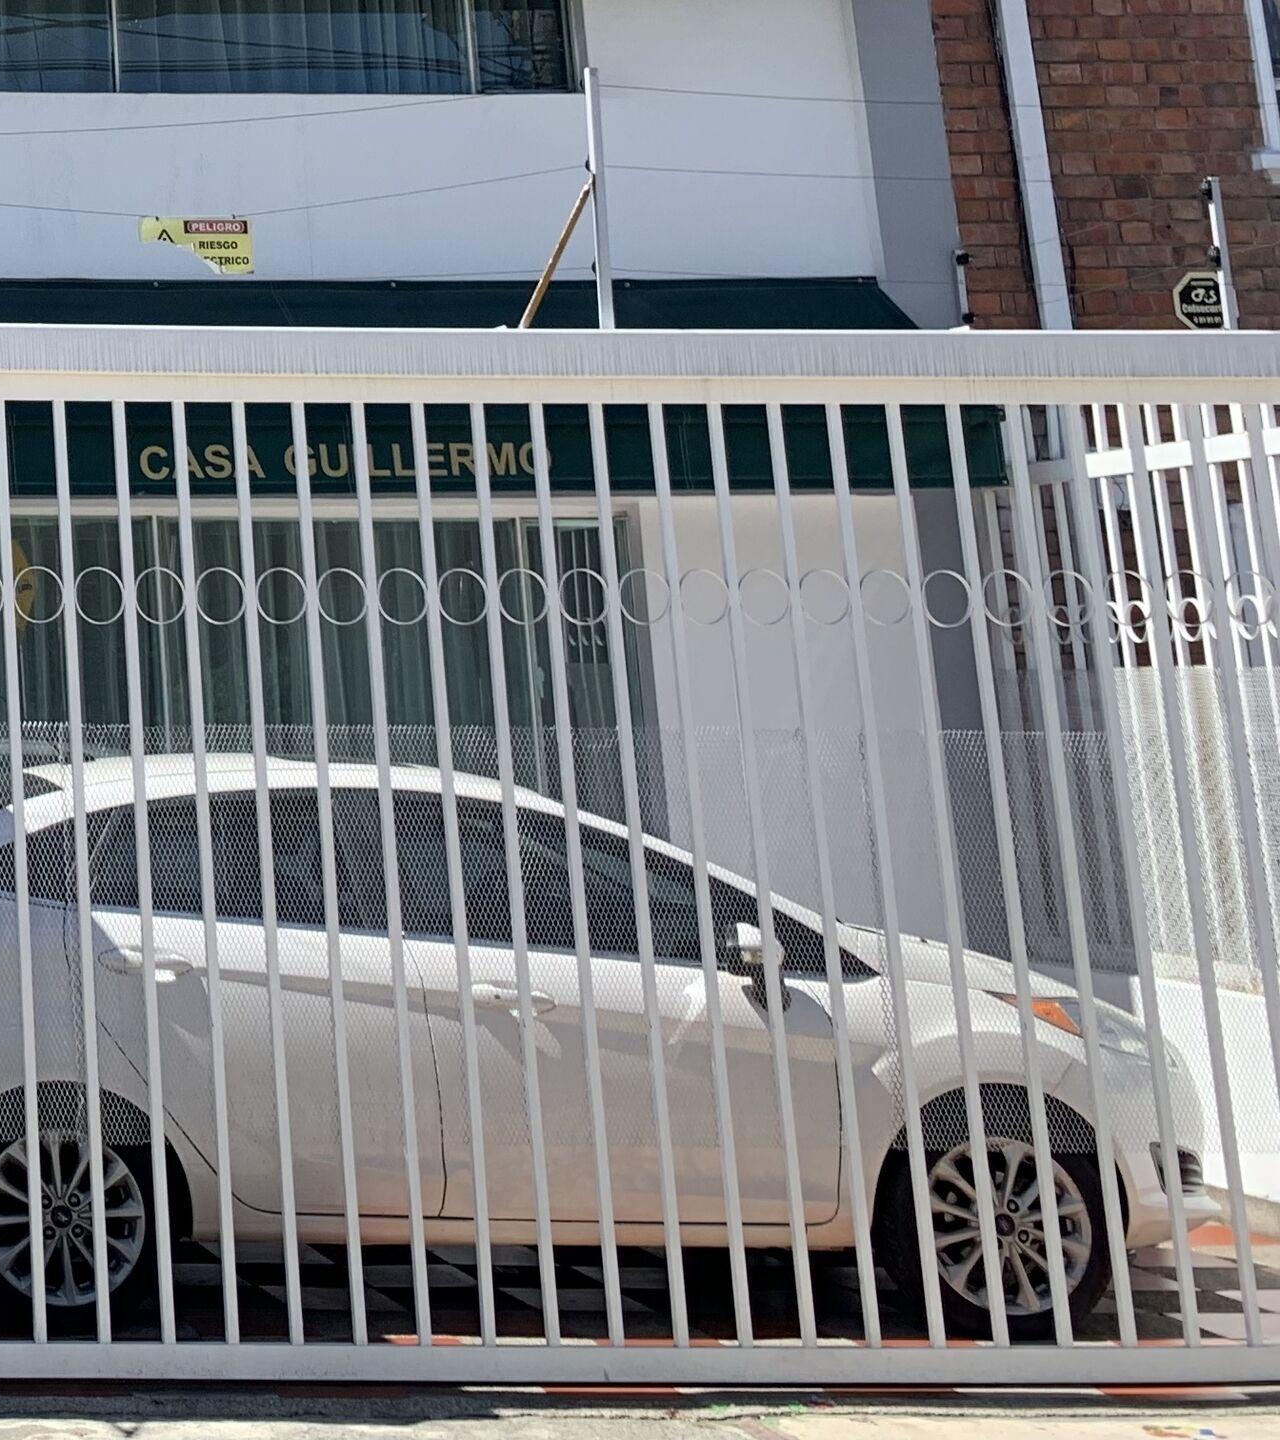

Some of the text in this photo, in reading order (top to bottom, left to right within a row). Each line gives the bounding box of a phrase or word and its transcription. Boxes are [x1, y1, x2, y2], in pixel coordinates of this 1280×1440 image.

[191, 222, 240, 232] PELIGRO
[199, 241, 238, 249] RIESGO
[204, 256, 249, 264] CTRICO
[140, 442, 551, 480] CASA GULLERMO
